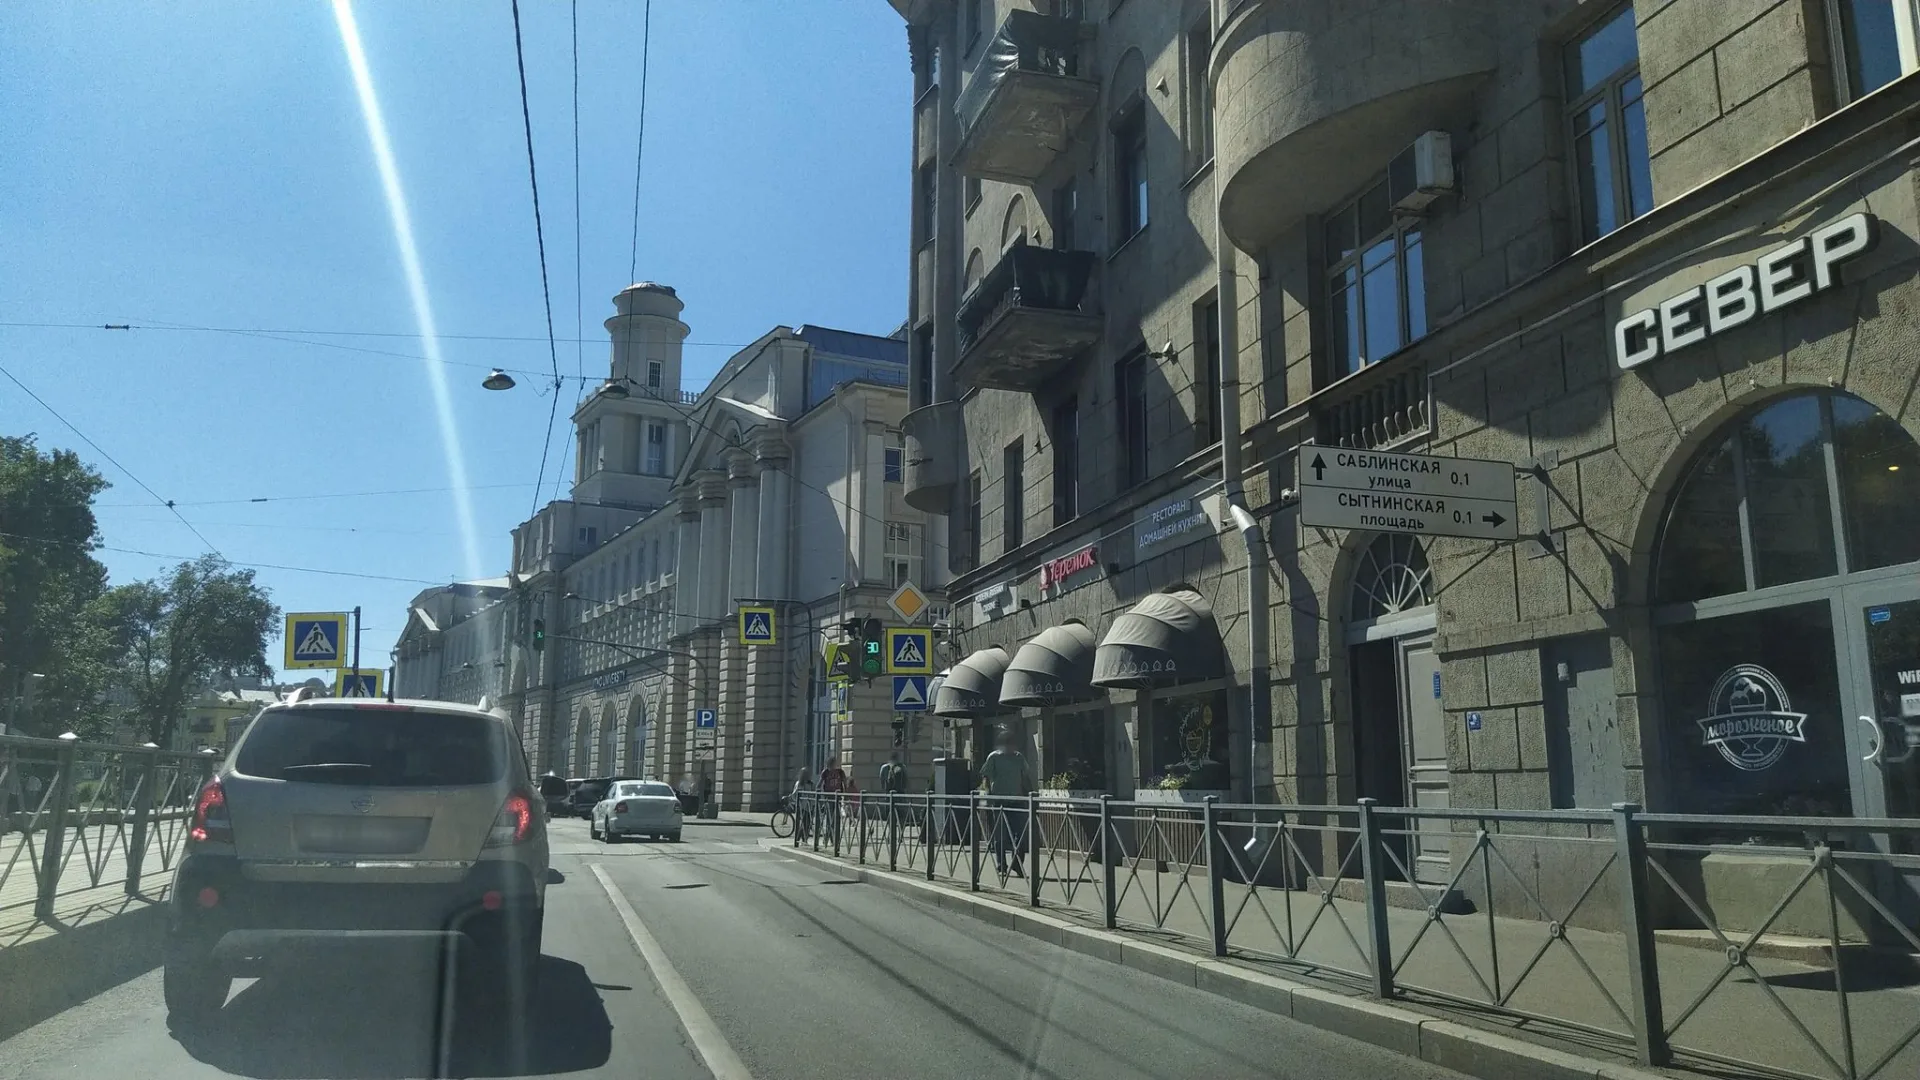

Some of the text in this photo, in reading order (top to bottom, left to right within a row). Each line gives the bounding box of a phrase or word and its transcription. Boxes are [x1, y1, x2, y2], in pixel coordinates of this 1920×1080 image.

[1614, 212, 1869, 370] СЕВЕР
[1336, 452, 1442, 475] САБЛИНСКАЯ
[1368, 475, 1412, 490] улица
[1151, 500, 1186, 523] РЕСТОРАН
[1337, 493, 1446, 514] СЫТНИНСКАЯ
[1139, 513, 1202, 549] ДОМАШНЕЙ КУХНИ
[1360, 513, 1425, 530] площадь
[867, 641, 879, 654] 30
[701, 711, 713, 726] P
